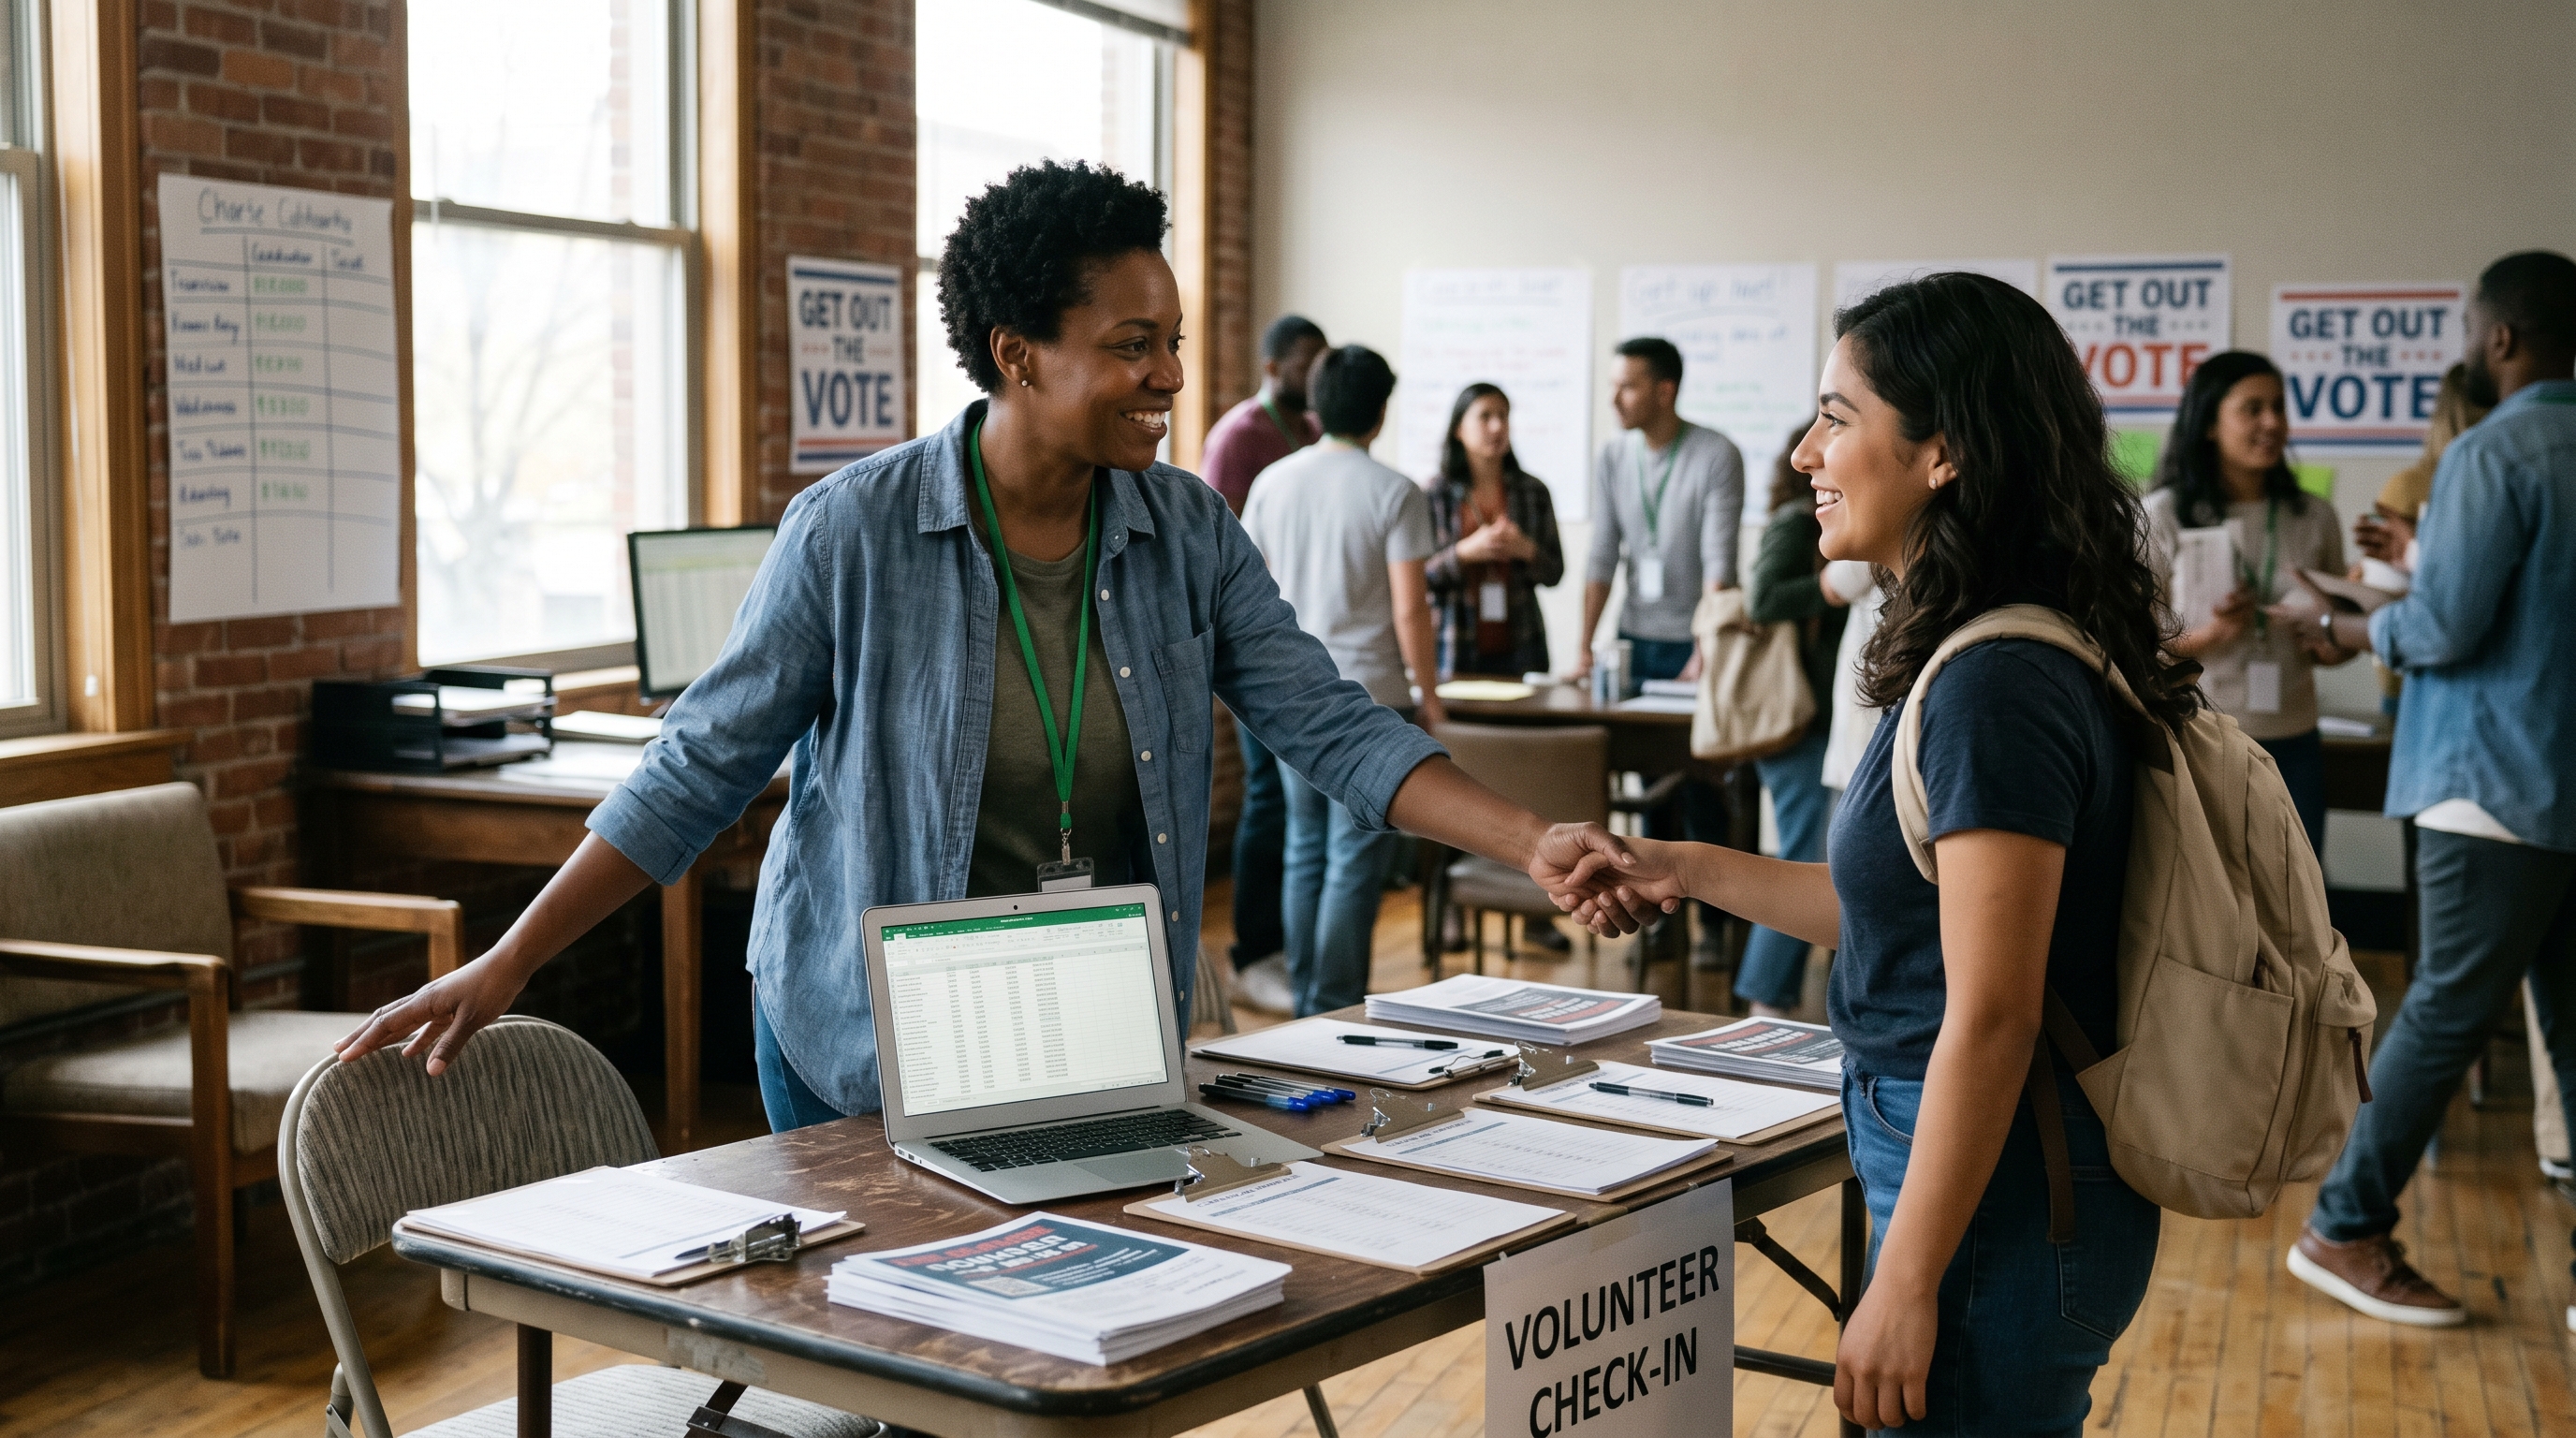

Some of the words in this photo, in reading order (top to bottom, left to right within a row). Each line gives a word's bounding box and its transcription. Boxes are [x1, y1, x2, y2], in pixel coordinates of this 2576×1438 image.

[799, 288, 843, 328] GET
[849, 293, 891, 332] OUT
[2064, 280, 2128, 309] GET
[2141, 279, 2211, 309] OUT
[2114, 315, 2159, 336] THE
[2291, 308, 2358, 339] GET
[2371, 307, 2446, 339] OUT
[832, 336, 864, 364] THE
[2342, 345, 2390, 366] THE
[801, 370, 893, 428] VOTE
[2290, 374, 2440, 418] VOTE
[1505, 1245, 1720, 1371] VOLUNTEER
[1530, 1327, 1697, 1438] CHECK-IN
